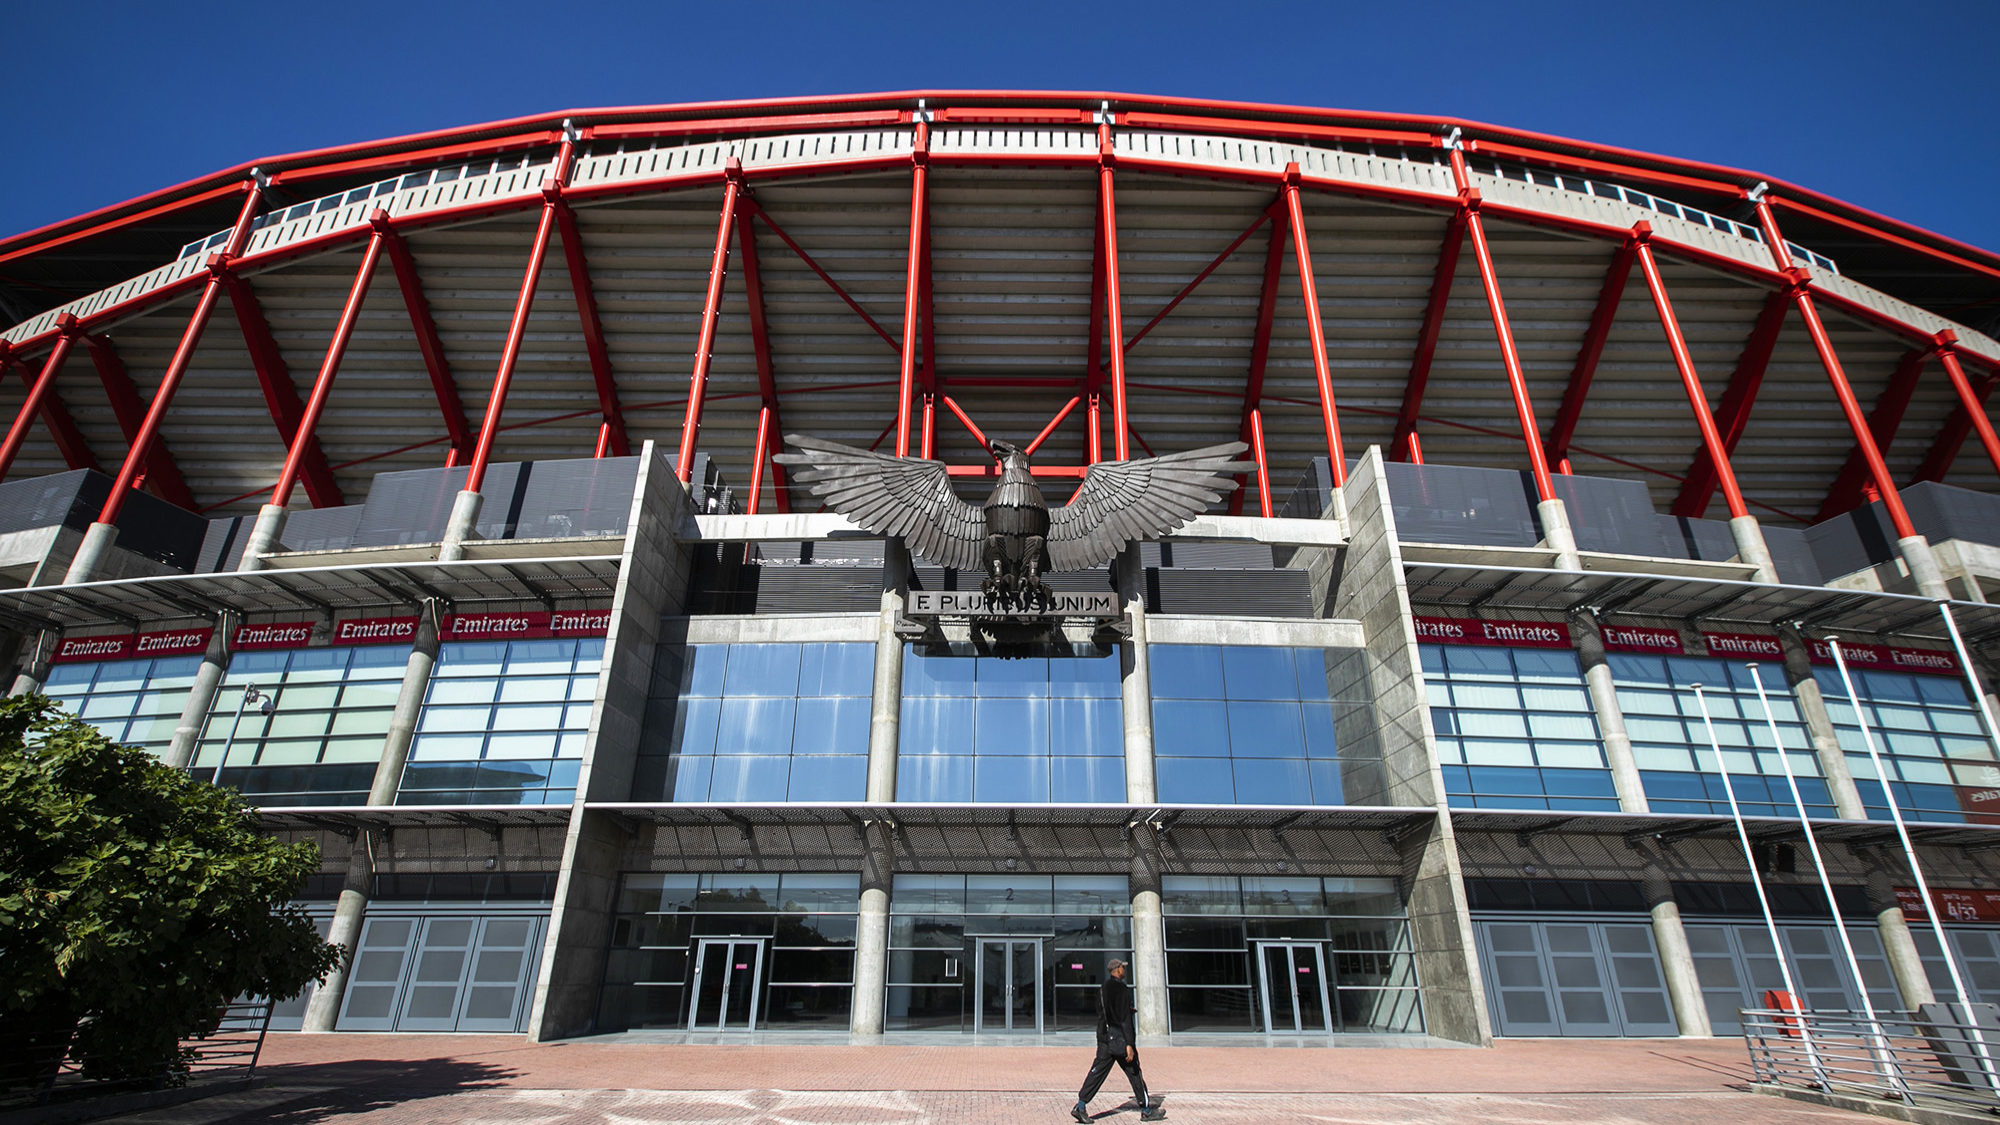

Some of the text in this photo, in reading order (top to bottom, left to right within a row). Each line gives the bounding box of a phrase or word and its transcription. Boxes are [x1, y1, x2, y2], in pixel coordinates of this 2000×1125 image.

[917, 595, 930, 610] E
[1053, 597, 1109, 611] UNUM
[341, 620, 414, 639] Emirates
[452, 616, 529, 634] Emirates
[1482, 623, 1560, 642] Emirates
[137, 633, 203, 651] Emirates
[237, 626, 308, 643] Emirates
[1604, 628, 1678, 648] Emirates
[61, 639, 124, 656] Emirates
[1707, 635, 1780, 655] Emirates
[1890, 650, 1953, 668] Emirates
[1005, 887, 1014, 901] 2
